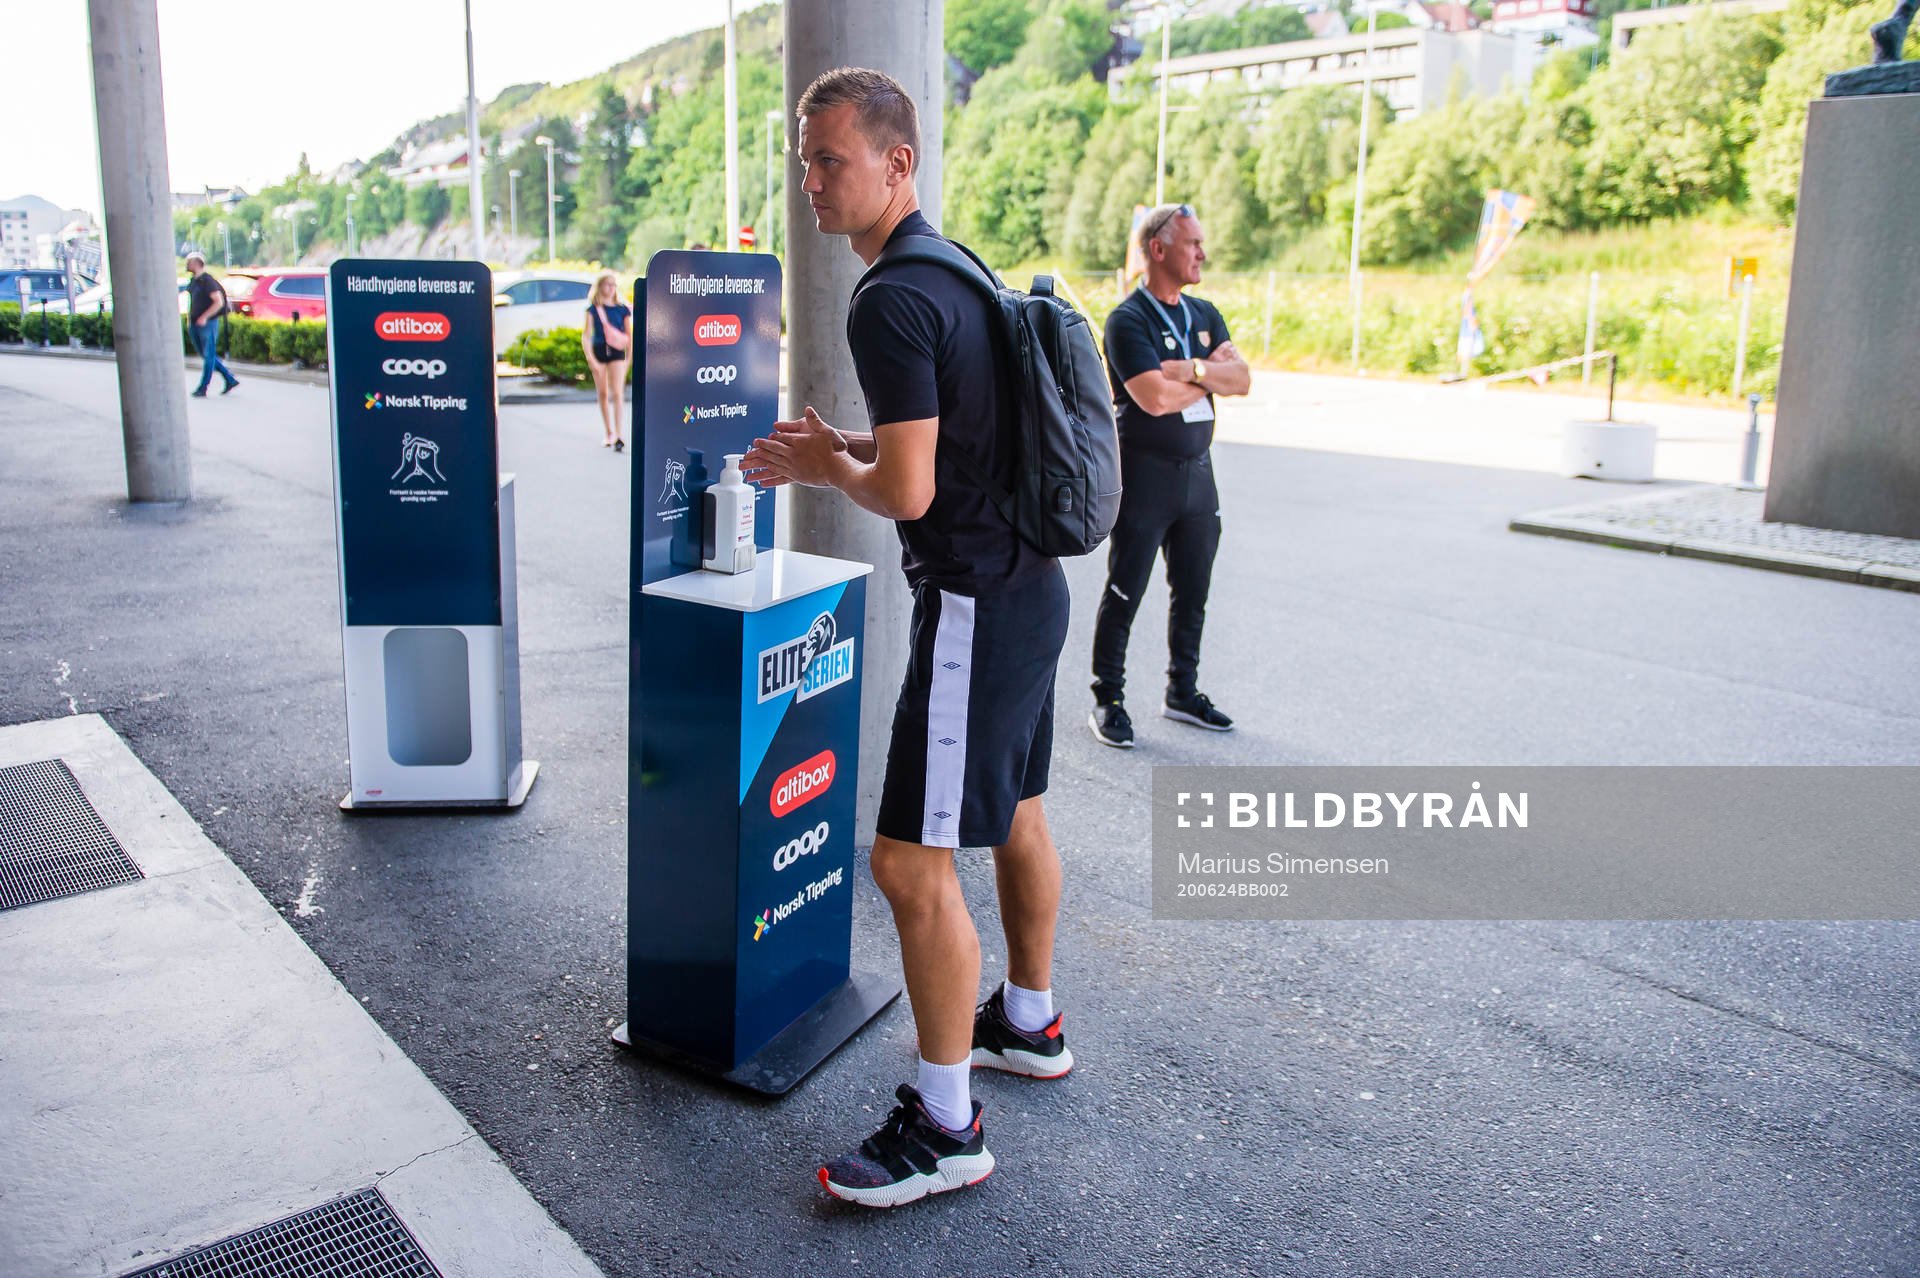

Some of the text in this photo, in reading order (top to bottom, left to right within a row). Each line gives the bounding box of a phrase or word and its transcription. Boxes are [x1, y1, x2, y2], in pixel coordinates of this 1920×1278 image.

[347, 275, 475, 295] Håndhygiene leveres av:
[670, 273, 765, 297] Håndhygiene leveres av:
[382, 316, 444, 335] altibox
[698, 320, 737, 339] altibox
[382, 358, 447, 379] coop
[696, 364, 737, 385] coop
[385, 395, 467, 411] Norsk Tipping
[697, 403, 748, 419] Norsk Tipping
[762, 641, 807, 696] ELITE
[803, 645, 850, 694] SERIEN
[776, 762, 830, 807] altibox
[773, 821, 829, 872] coop
[773, 867, 843, 925] Norsk Tipping
